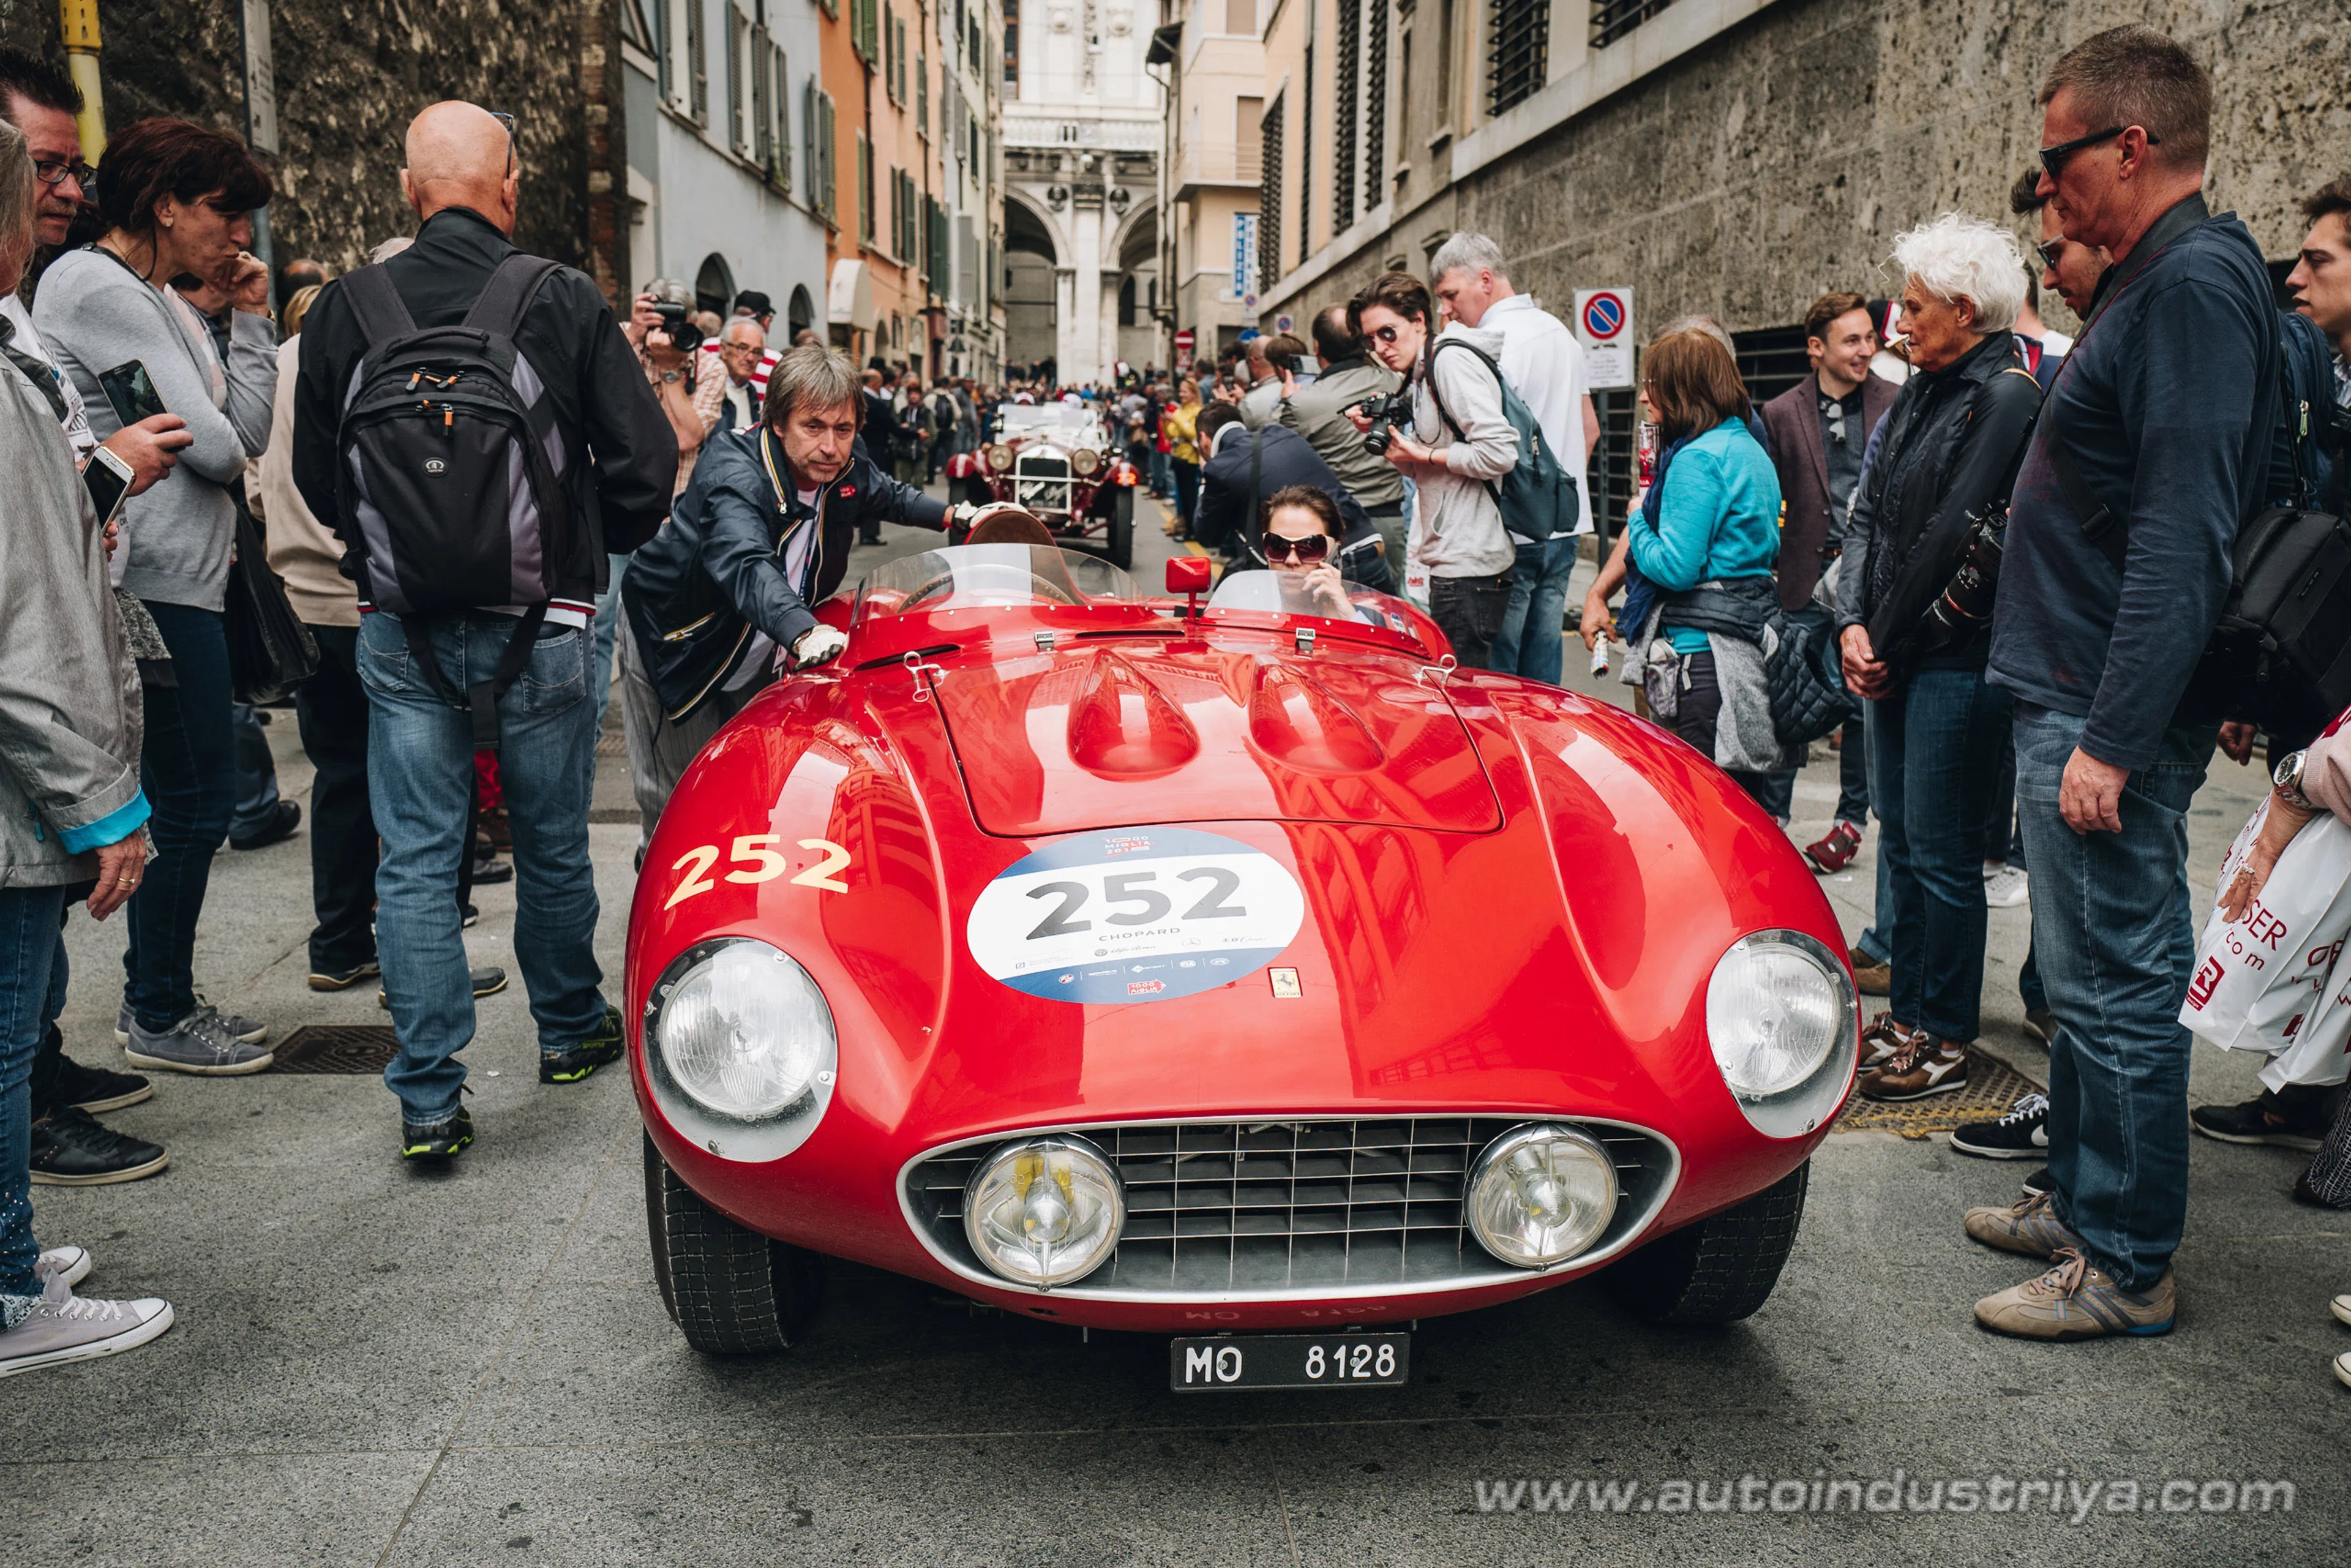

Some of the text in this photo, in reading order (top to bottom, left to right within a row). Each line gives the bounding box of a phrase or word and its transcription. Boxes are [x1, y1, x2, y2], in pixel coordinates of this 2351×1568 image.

[664, 834, 851, 911] 252
[1026, 867, 1247, 940] 252
[1099, 928, 1180, 942] CHOPARD
[1185, 1344, 1396, 1383] MO 8128
